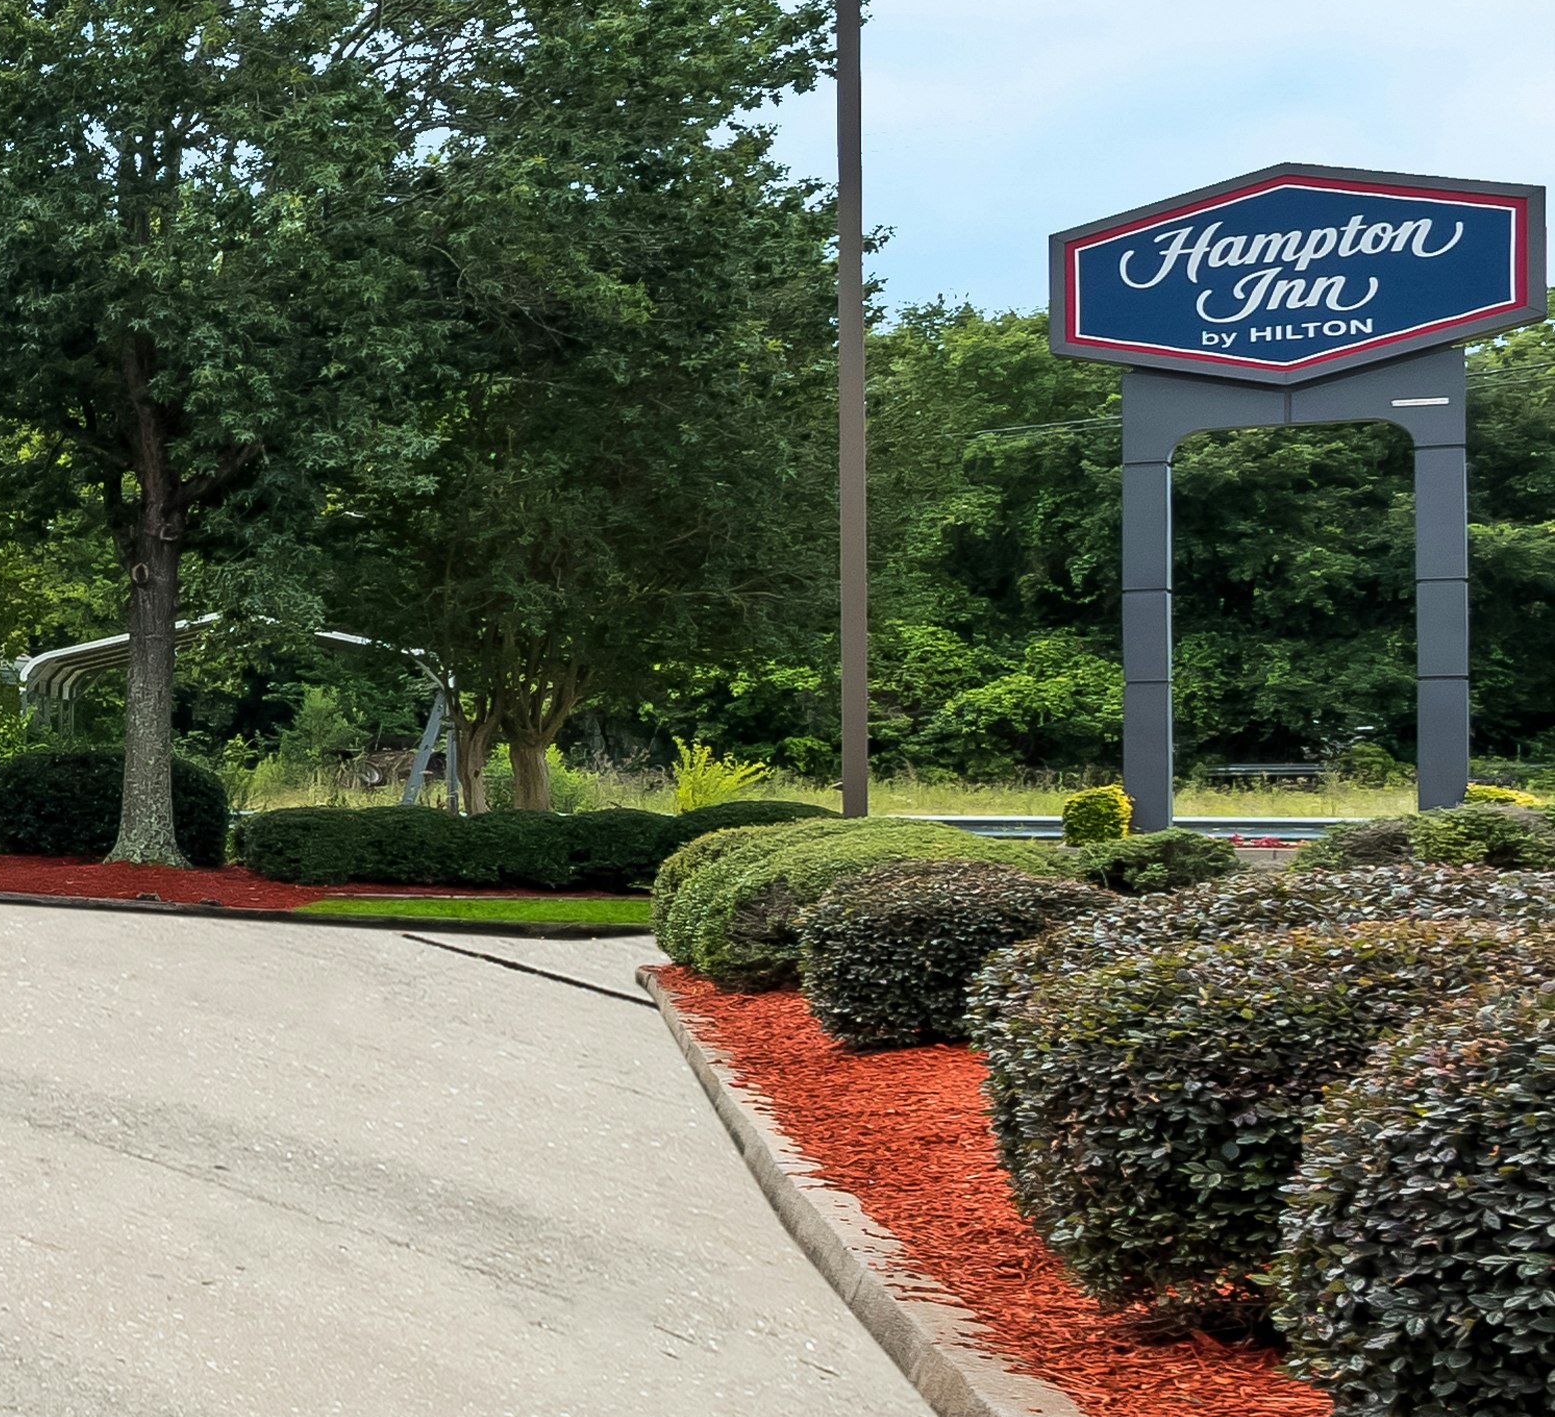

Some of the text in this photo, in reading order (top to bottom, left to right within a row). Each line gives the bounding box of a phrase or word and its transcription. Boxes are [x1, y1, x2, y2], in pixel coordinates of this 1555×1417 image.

[1119, 214, 1463, 288] Hampton
[1196, 268, 1378, 323] Inn
[1201, 318, 1373, 349] by HILTON
